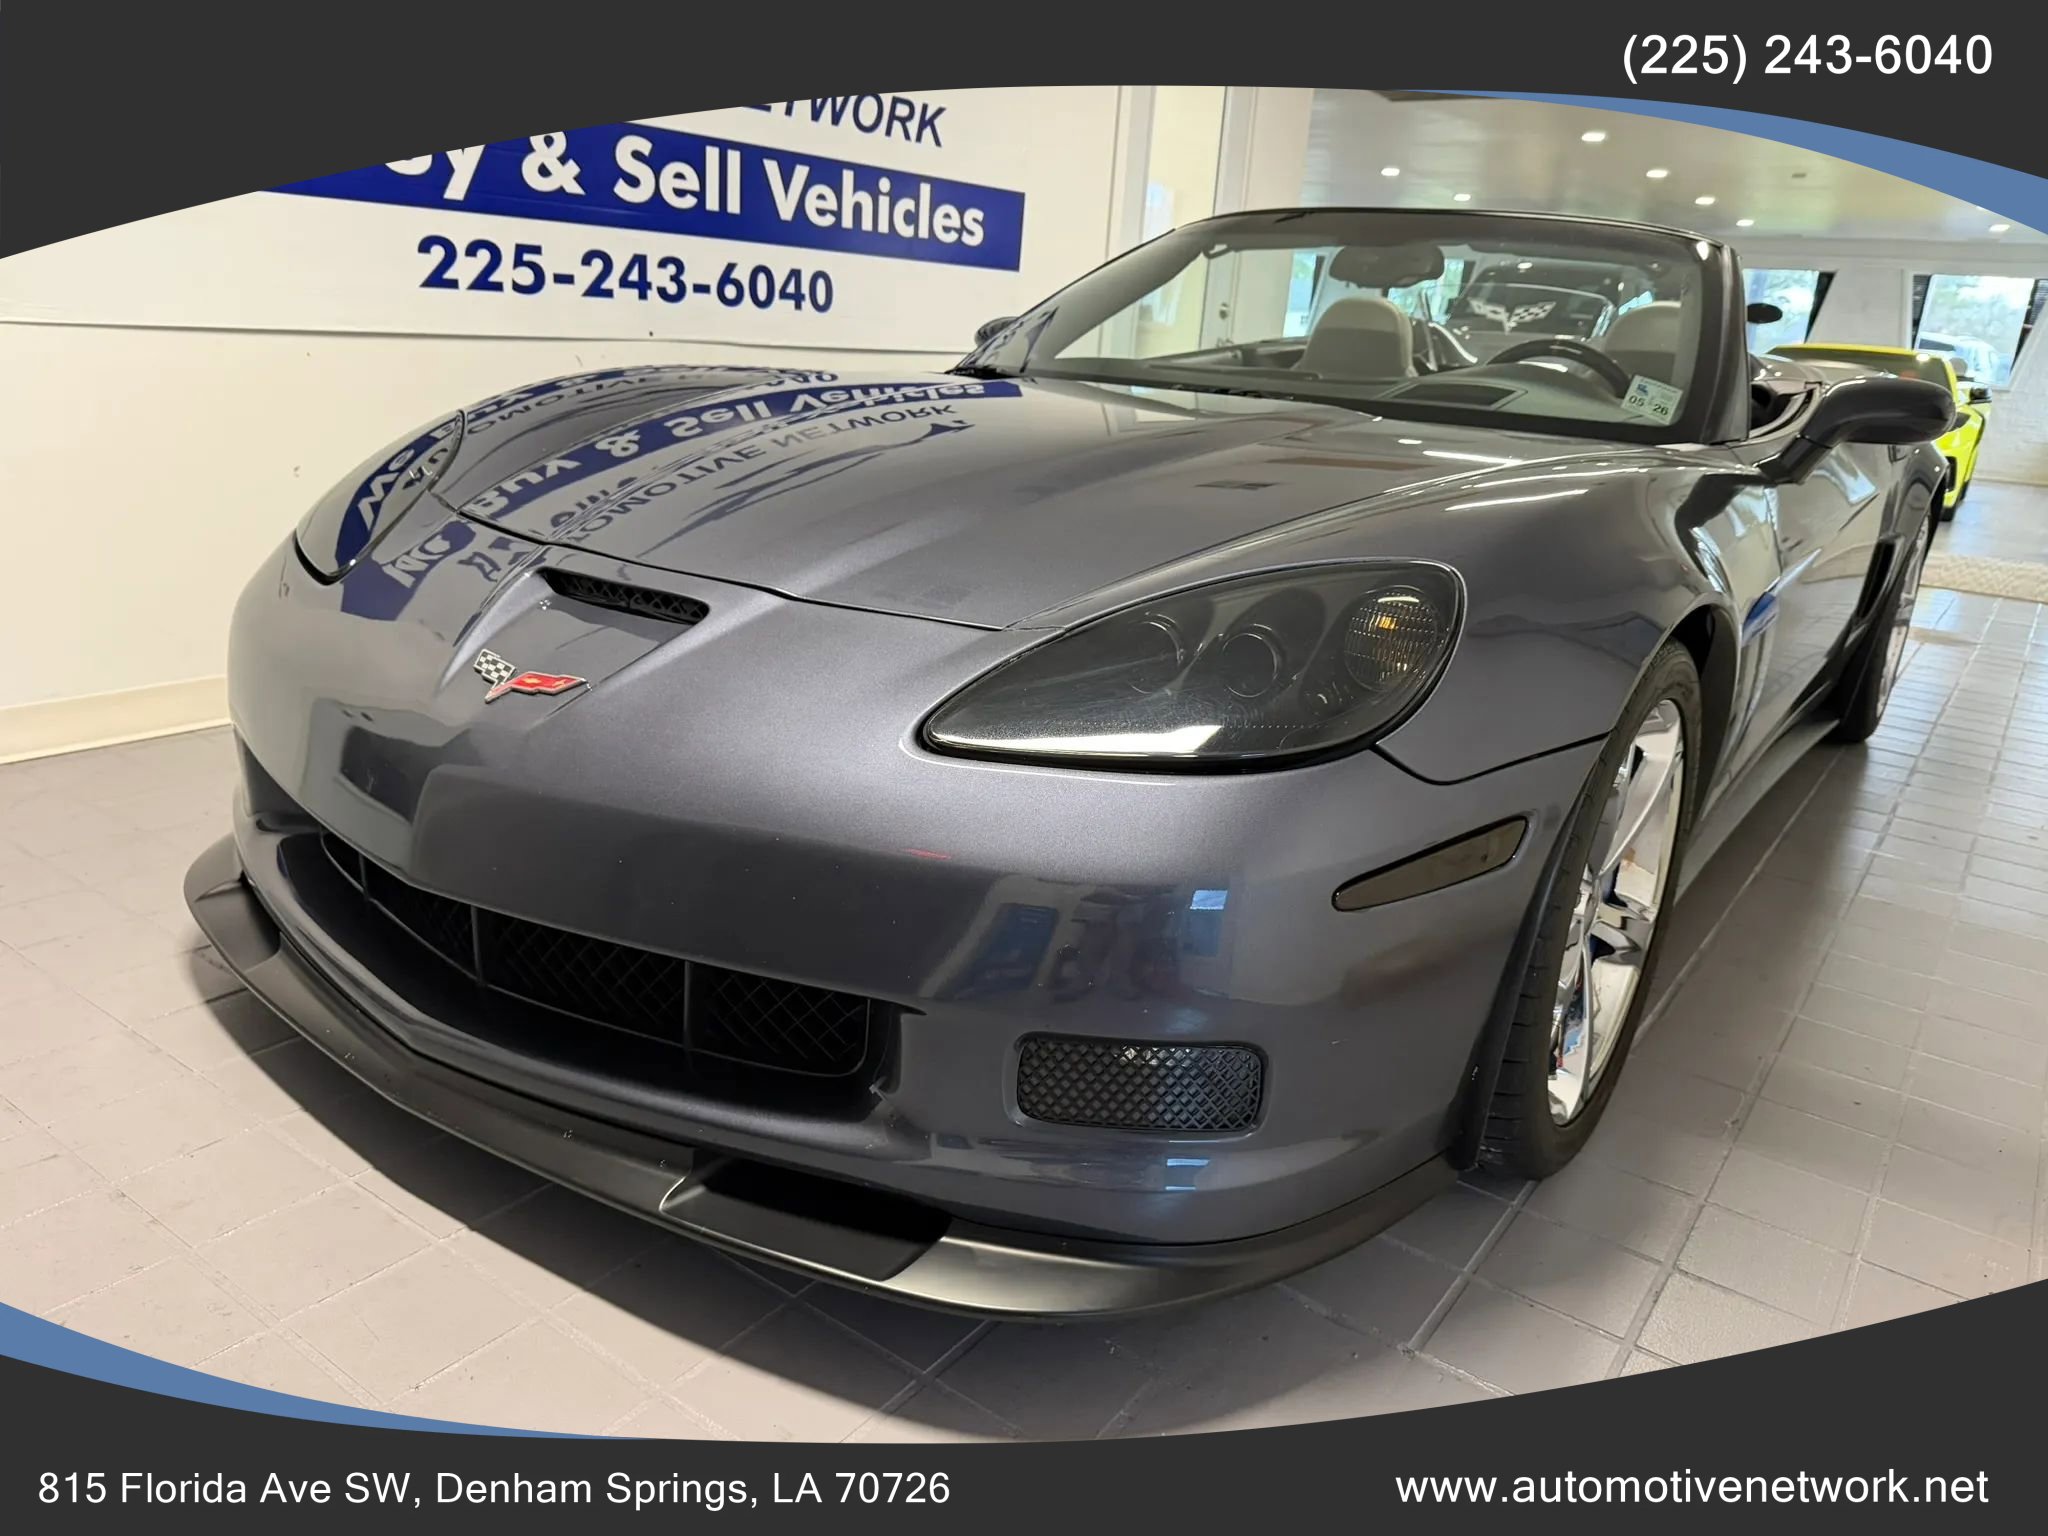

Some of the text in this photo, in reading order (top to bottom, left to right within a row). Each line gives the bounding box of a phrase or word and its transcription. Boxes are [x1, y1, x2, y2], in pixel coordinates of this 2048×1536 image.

[742, 91, 947, 148] WORK
[522, 131, 586, 196] &
[613, 135, 741, 215] Sell
[762, 158, 984, 247] Vehicles
[417, 234, 834, 313] 225-243-6040
[1629, 395, 1669, 416] 05 26
